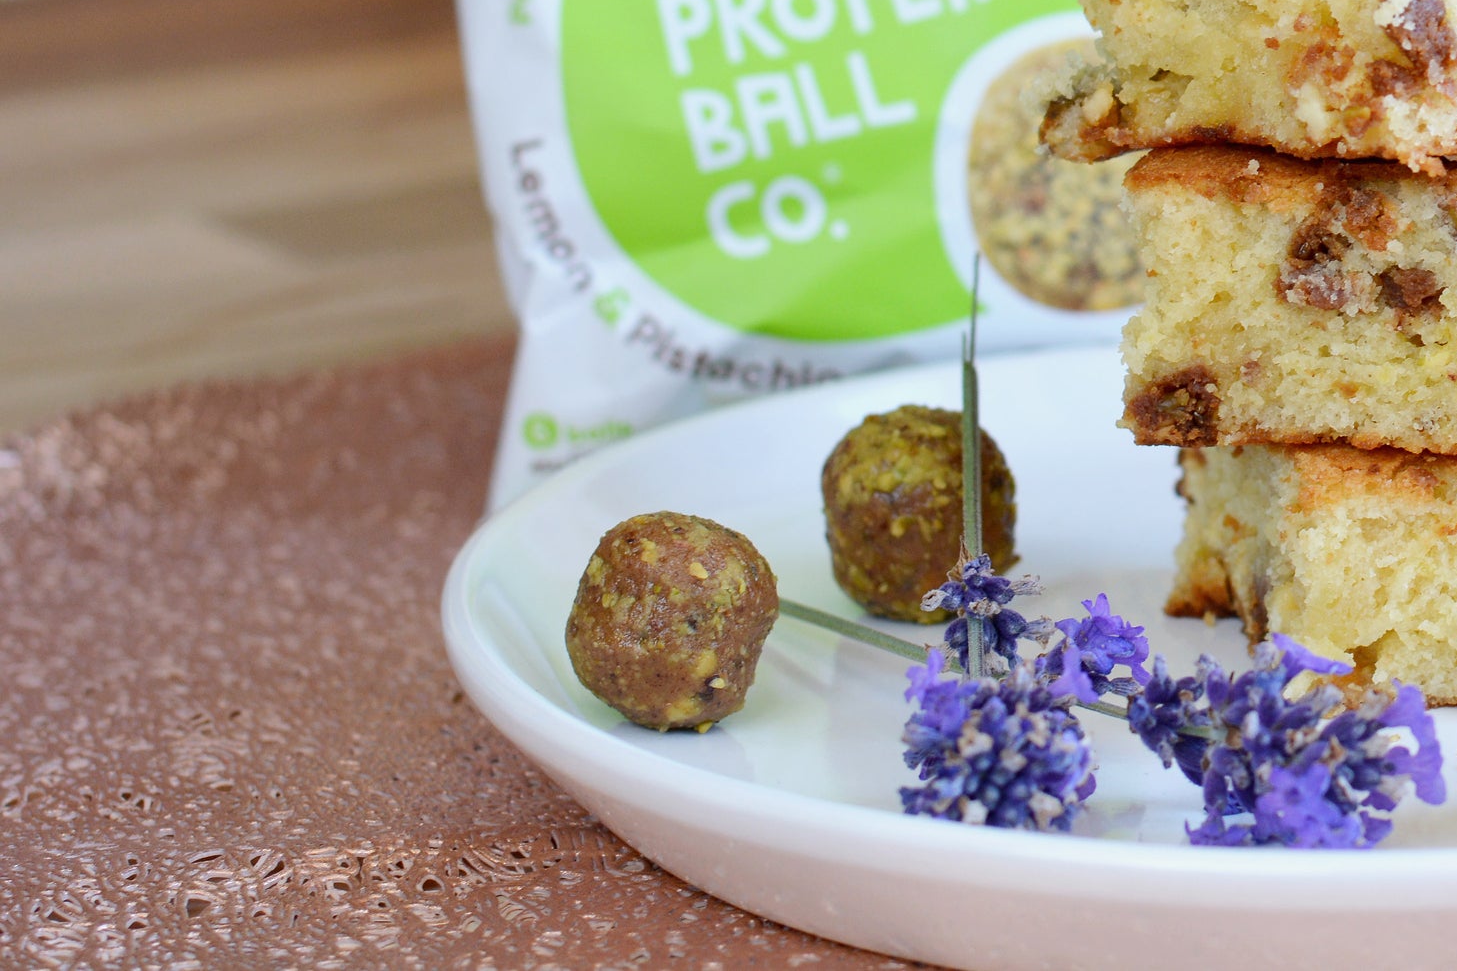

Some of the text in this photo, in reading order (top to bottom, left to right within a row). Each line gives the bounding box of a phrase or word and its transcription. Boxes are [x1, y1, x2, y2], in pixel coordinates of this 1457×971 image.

[680, 50, 917, 173] BALL
[510, 137, 594, 294] Lemon
[706, 174, 850, 259] CO.
